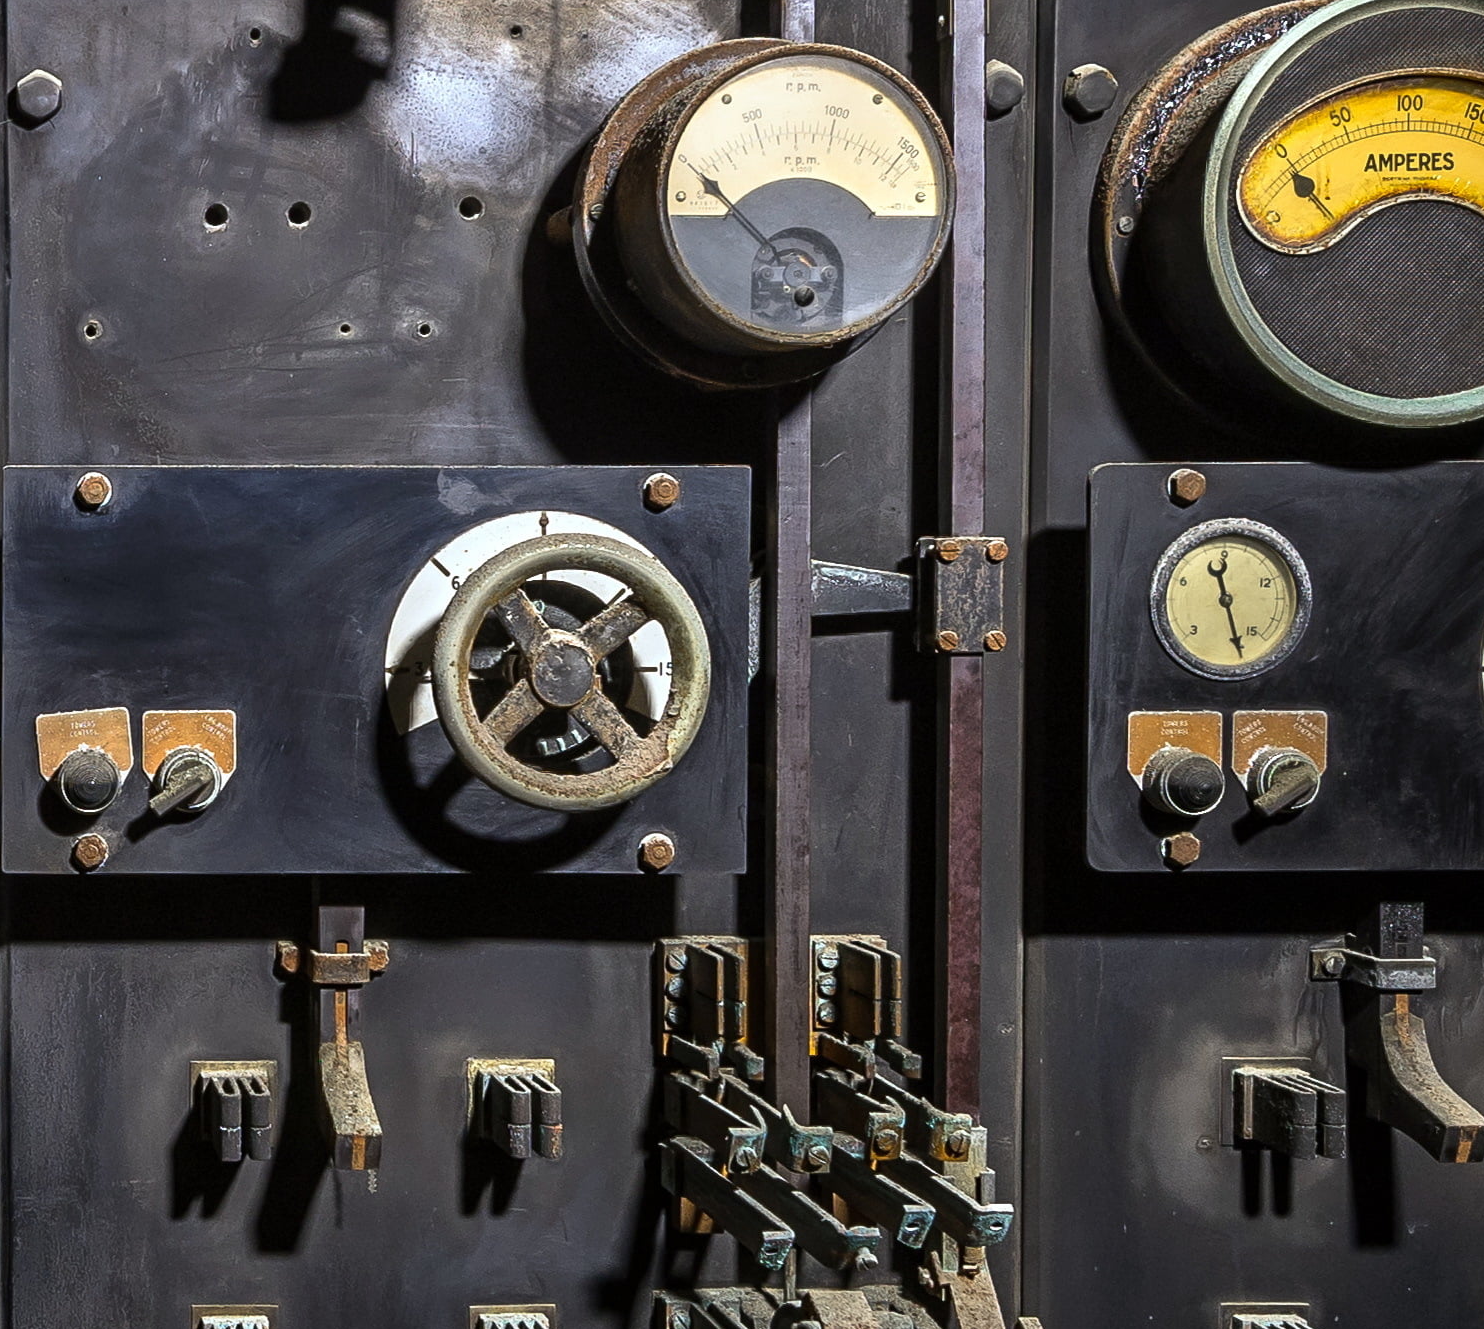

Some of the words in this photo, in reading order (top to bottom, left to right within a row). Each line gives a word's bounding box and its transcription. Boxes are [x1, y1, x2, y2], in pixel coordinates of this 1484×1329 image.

[1396, 95, 1424, 112] 100
[742, 108, 763, 124] 500
[824, 104, 850, 120] 1000
[1329, 106, 1352, 127] 50
[896, 136, 920, 160] 1500
[1274, 143, 1288, 159] 0
[678, 154, 688, 165] 0
[1363, 151, 1456, 173] AMPERES
[450, 575, 461, 591] 6
[1179, 577, 1188, 587] 6
[1259, 577, 1272, 588] 12
[1189, 625, 1198, 635] 3
[1246, 626, 1258, 636] 15
[414, 661, 425, 676] 3
